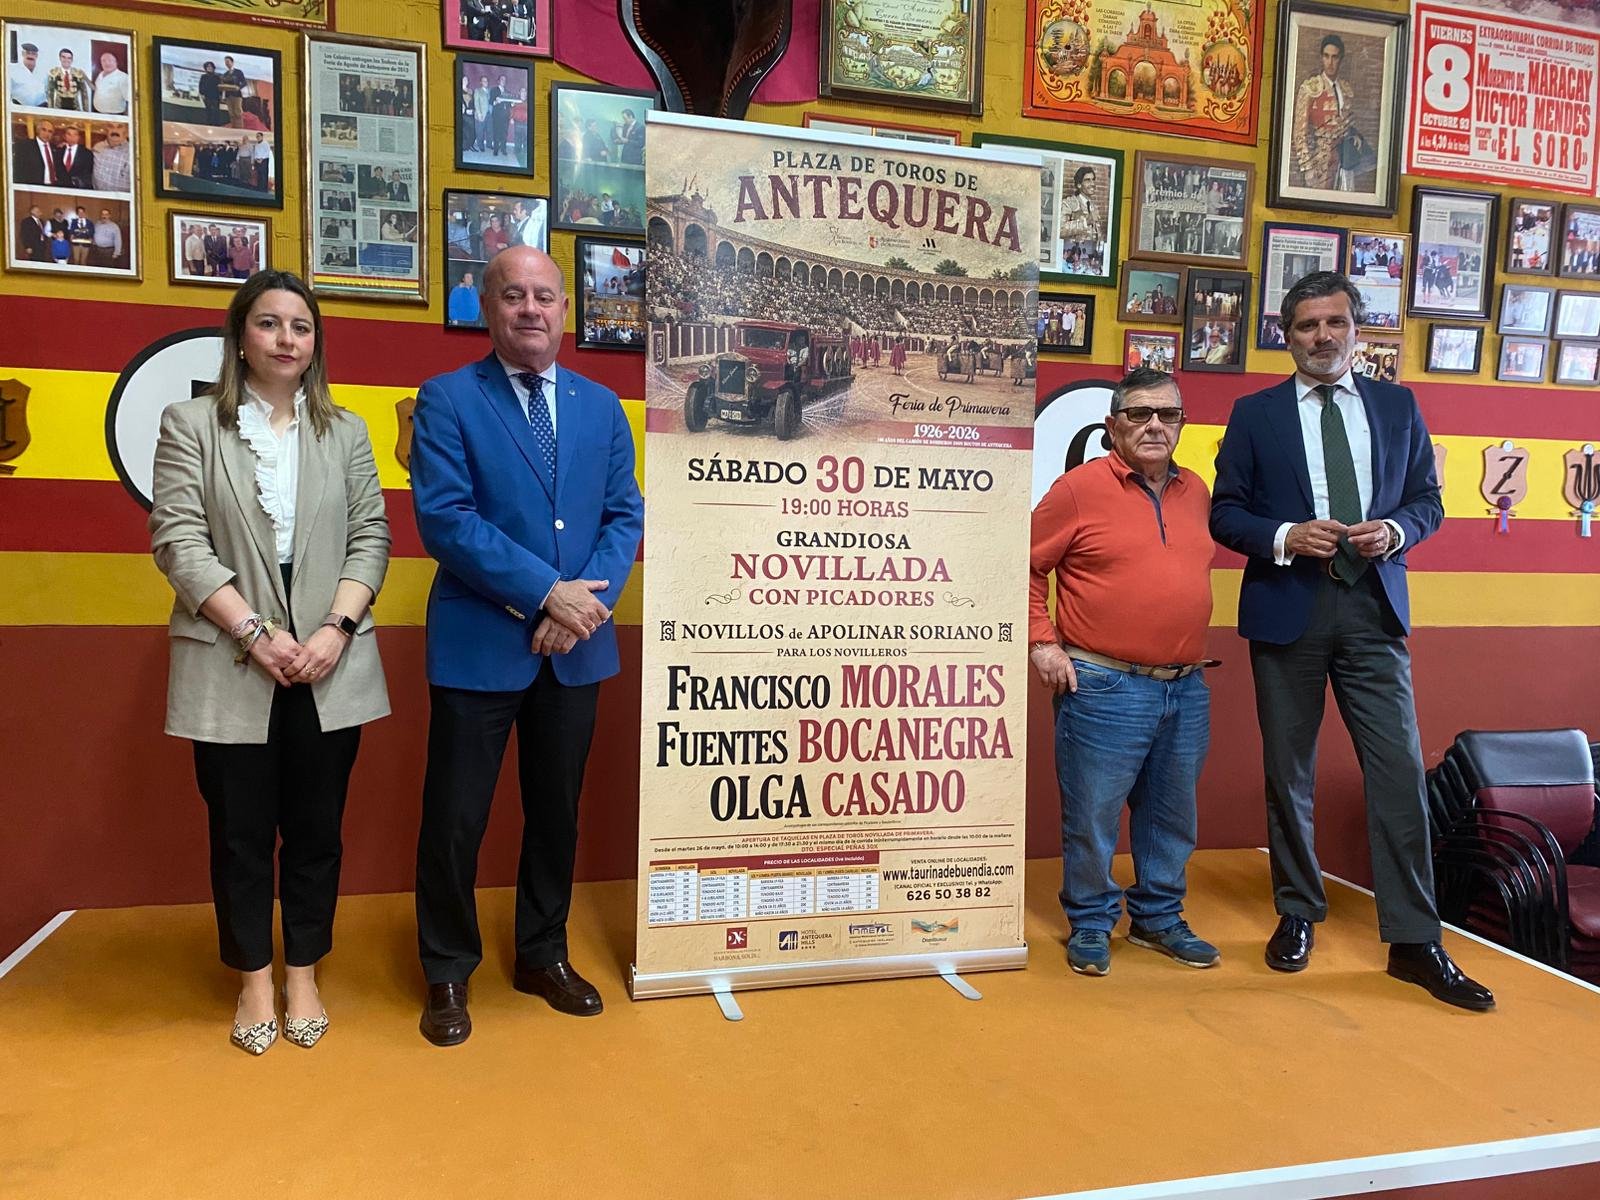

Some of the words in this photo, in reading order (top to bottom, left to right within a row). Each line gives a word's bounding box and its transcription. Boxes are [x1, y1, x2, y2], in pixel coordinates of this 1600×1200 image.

[1430, 24, 1472, 44] VIERNES
[1479, 26, 1534, 45] EXTRAORDINARIA
[1536, 35, 1564, 50] CORRIDA
[1566, 40, 1573, 52] DE
[1575, 42, 1594, 56] TOROS
[1424, 44, 1470, 112] 8
[1478, 53, 1516, 91] MORENITO
[1516, 72, 1525, 91] DE
[1528, 61, 1592, 102] MARACAY
[1423, 112, 1458, 128] OCTUBRE
[1476, 90, 1527, 128] VICTOR
[1533, 98, 1590, 138] MENDES
[773, 150, 842, 170] PLAZA
[850, 156, 876, 174] DE
[883, 159, 947, 185] TOROS
[954, 171, 978, 192] DE
[734, 174, 1022, 252] ANTEQUERA
[888, 393, 926, 416] Feria
[928, 396, 943, 412] de
[945, 396, 1012, 418] Primavera
[913, 424, 980, 440] 1926-2026
[688, 452, 807, 484] SÁBADO
[816, 455, 865, 494] 30
[874, 466, 910, 489] DE
[918, 468, 994, 492] MAYO
[781, 498, 831, 516] 19:00
[837, 500, 909, 518] HORAS
[776, 530, 912, 550] GRANDIOSA
[730, 553, 953, 583] NOVILLADA
[748, 588, 800, 606] CON
[805, 589, 935, 607] PICADORES
[682, 624, 784, 641] NOVILLOS
[788, 628, 803, 640] de
[806, 624, 905, 641] APOLINAR
[910, 625, 994, 641] SORIANO
[777, 648, 807, 657] PARA
[809, 648, 832, 657] LOS
[834, 648, 908, 658] NOVILLEROS
[666, 665, 831, 711] FRANCISCO
[840, 664, 1006, 708] MORALES
[656, 721, 788, 768] FUENTES
[798, 717, 1014, 764] BOCANEGRA
[710, 774, 812, 822] OLGA
[821, 769, 966, 818] CASADO
[882, 862, 1014, 880] www.taurinadebuendia.com
[906, 889, 931, 900] 626
[935, 889, 951, 899] 50
[956, 888, 971, 898] 38
[975, 887, 991, 897] 82
